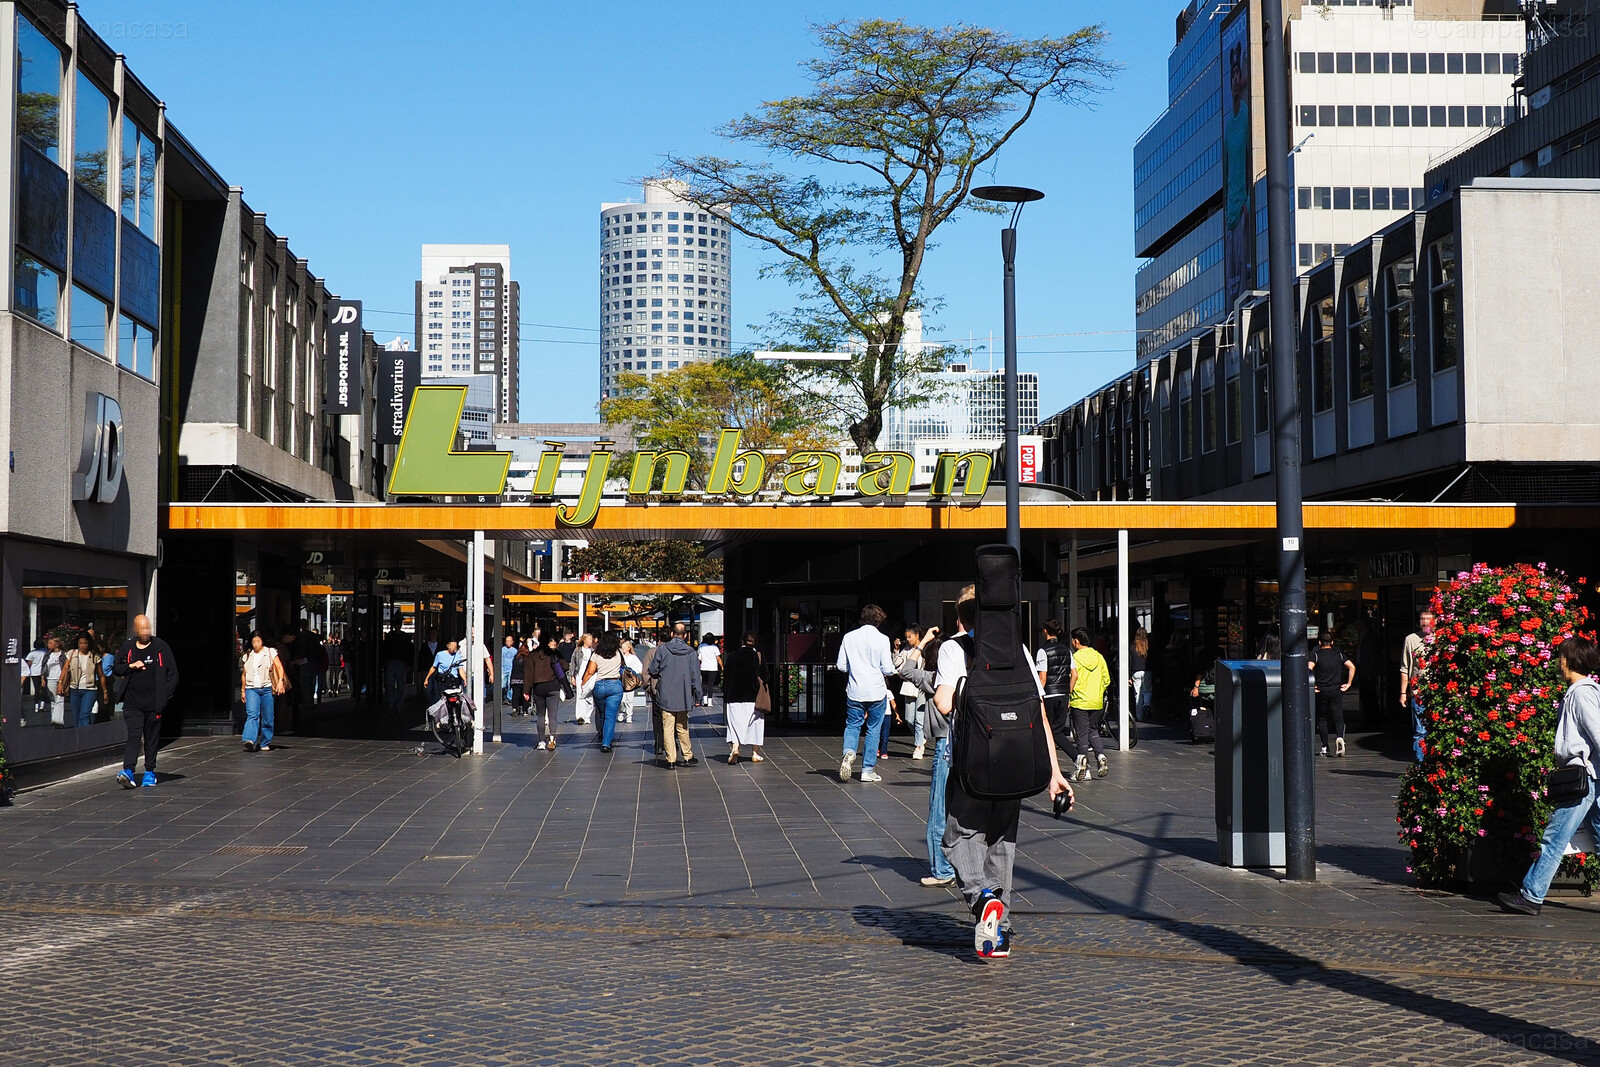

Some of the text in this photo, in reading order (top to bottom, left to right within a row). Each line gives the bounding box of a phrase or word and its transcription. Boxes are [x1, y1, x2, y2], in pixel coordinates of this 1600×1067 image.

[331, 306, 358, 324] JD
[338, 331, 349, 408] JDSPORTS.NL
[390, 358, 404, 436] stradivarius
[72, 391, 124, 503] JD
[387, 384, 993, 527] Lijnbaan
[1022, 447, 1034, 466] POP
[305, 551, 324, 565] JD
[374, 568, 389, 579] JD
